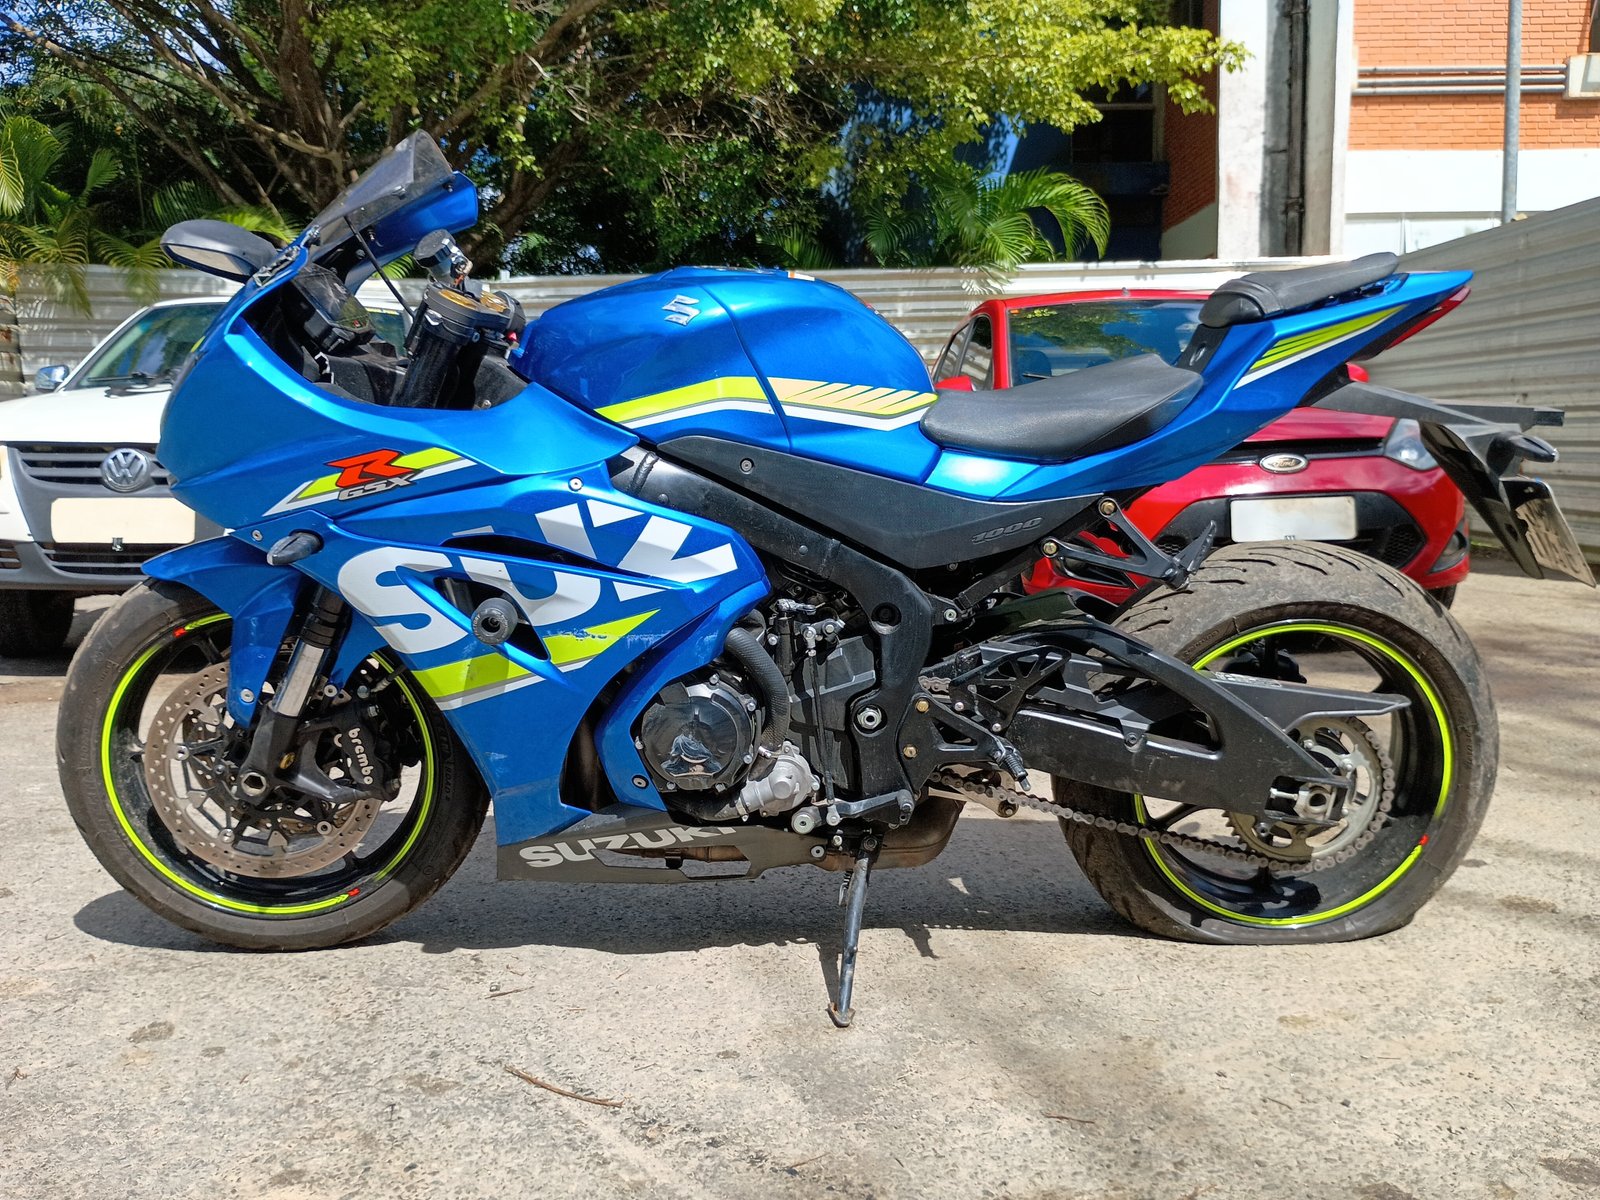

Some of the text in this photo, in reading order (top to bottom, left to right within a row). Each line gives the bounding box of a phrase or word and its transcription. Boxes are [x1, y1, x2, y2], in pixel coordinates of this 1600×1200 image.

[325, 448, 416, 487] R
[337, 476, 413, 501] GSX
[971, 517, 1044, 545] 1000
[348, 727, 375, 785] brembo
